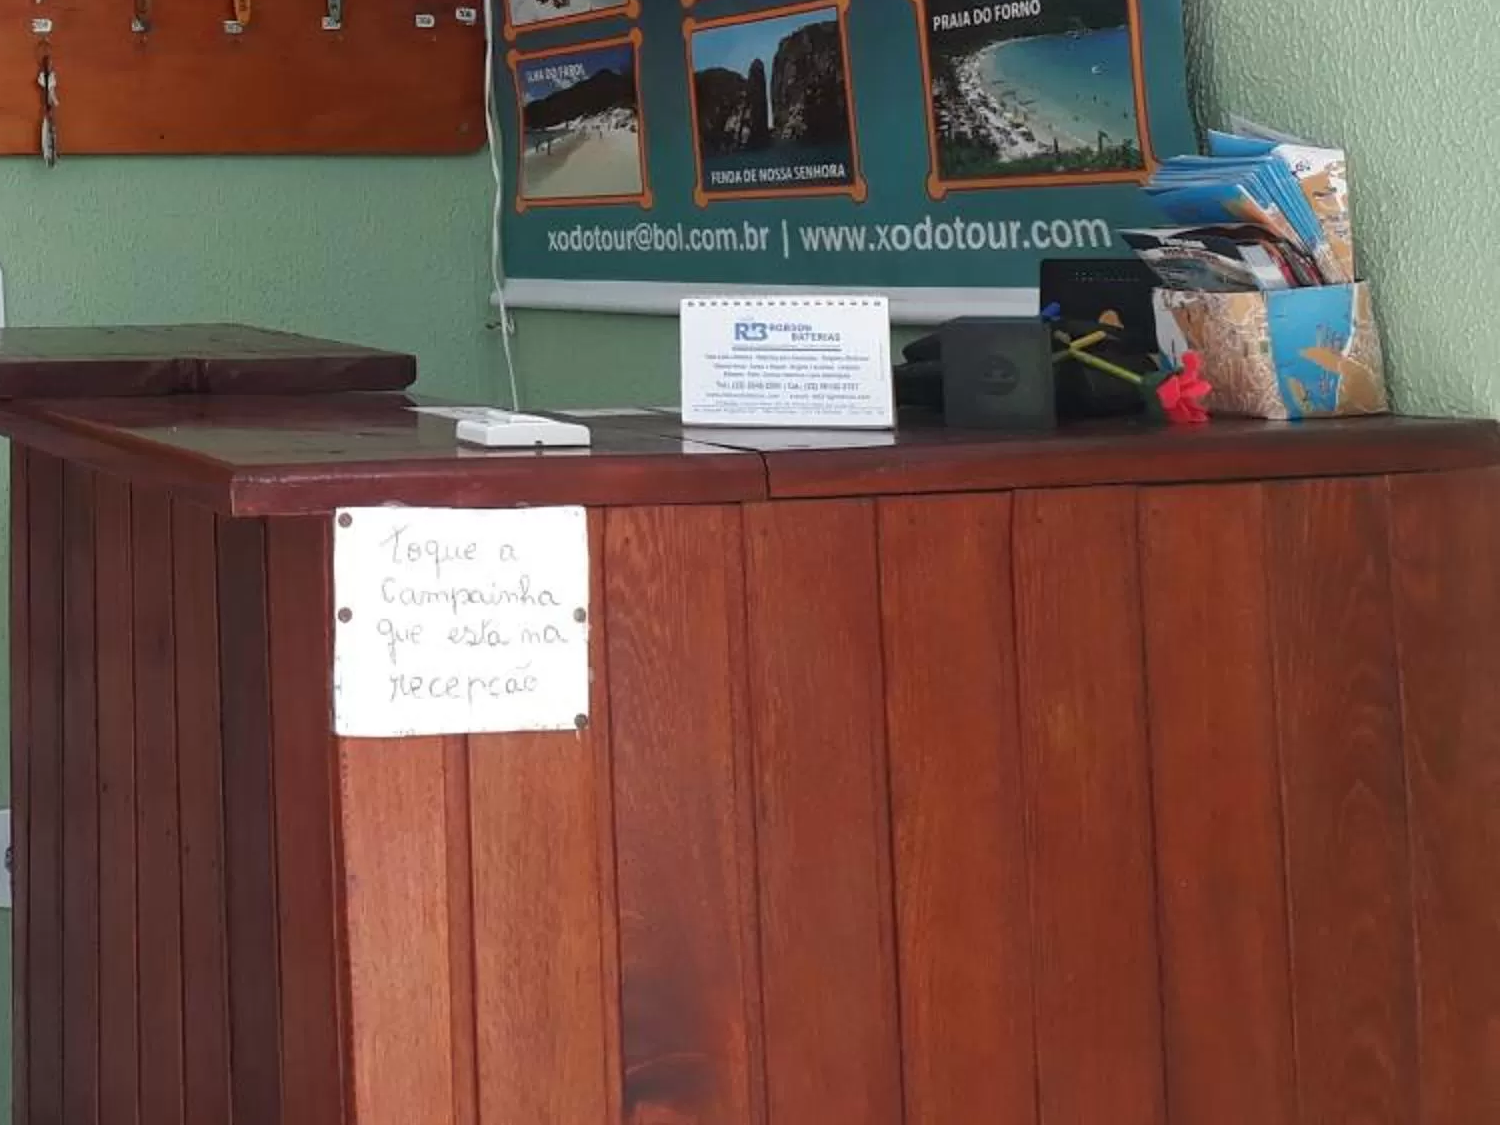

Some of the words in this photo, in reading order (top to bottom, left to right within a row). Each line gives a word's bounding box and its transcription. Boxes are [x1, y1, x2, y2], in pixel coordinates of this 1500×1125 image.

[932, 11, 971, 32] PRAIA
[973, 7, 992, 25] DO
[711, 170, 742, 185] FENDA
[744, 169, 757, 183] DE
[759, 167, 793, 182] NOSSA
[793, 162, 846, 180] SENHORA
[548, 220, 769, 252] xodotour@bol.com.br
[799, 215, 1112, 251] www.xodotour.com
[499, 543, 518, 562] a
[376, 618, 423, 666] que
[521, 624, 569, 644] na
